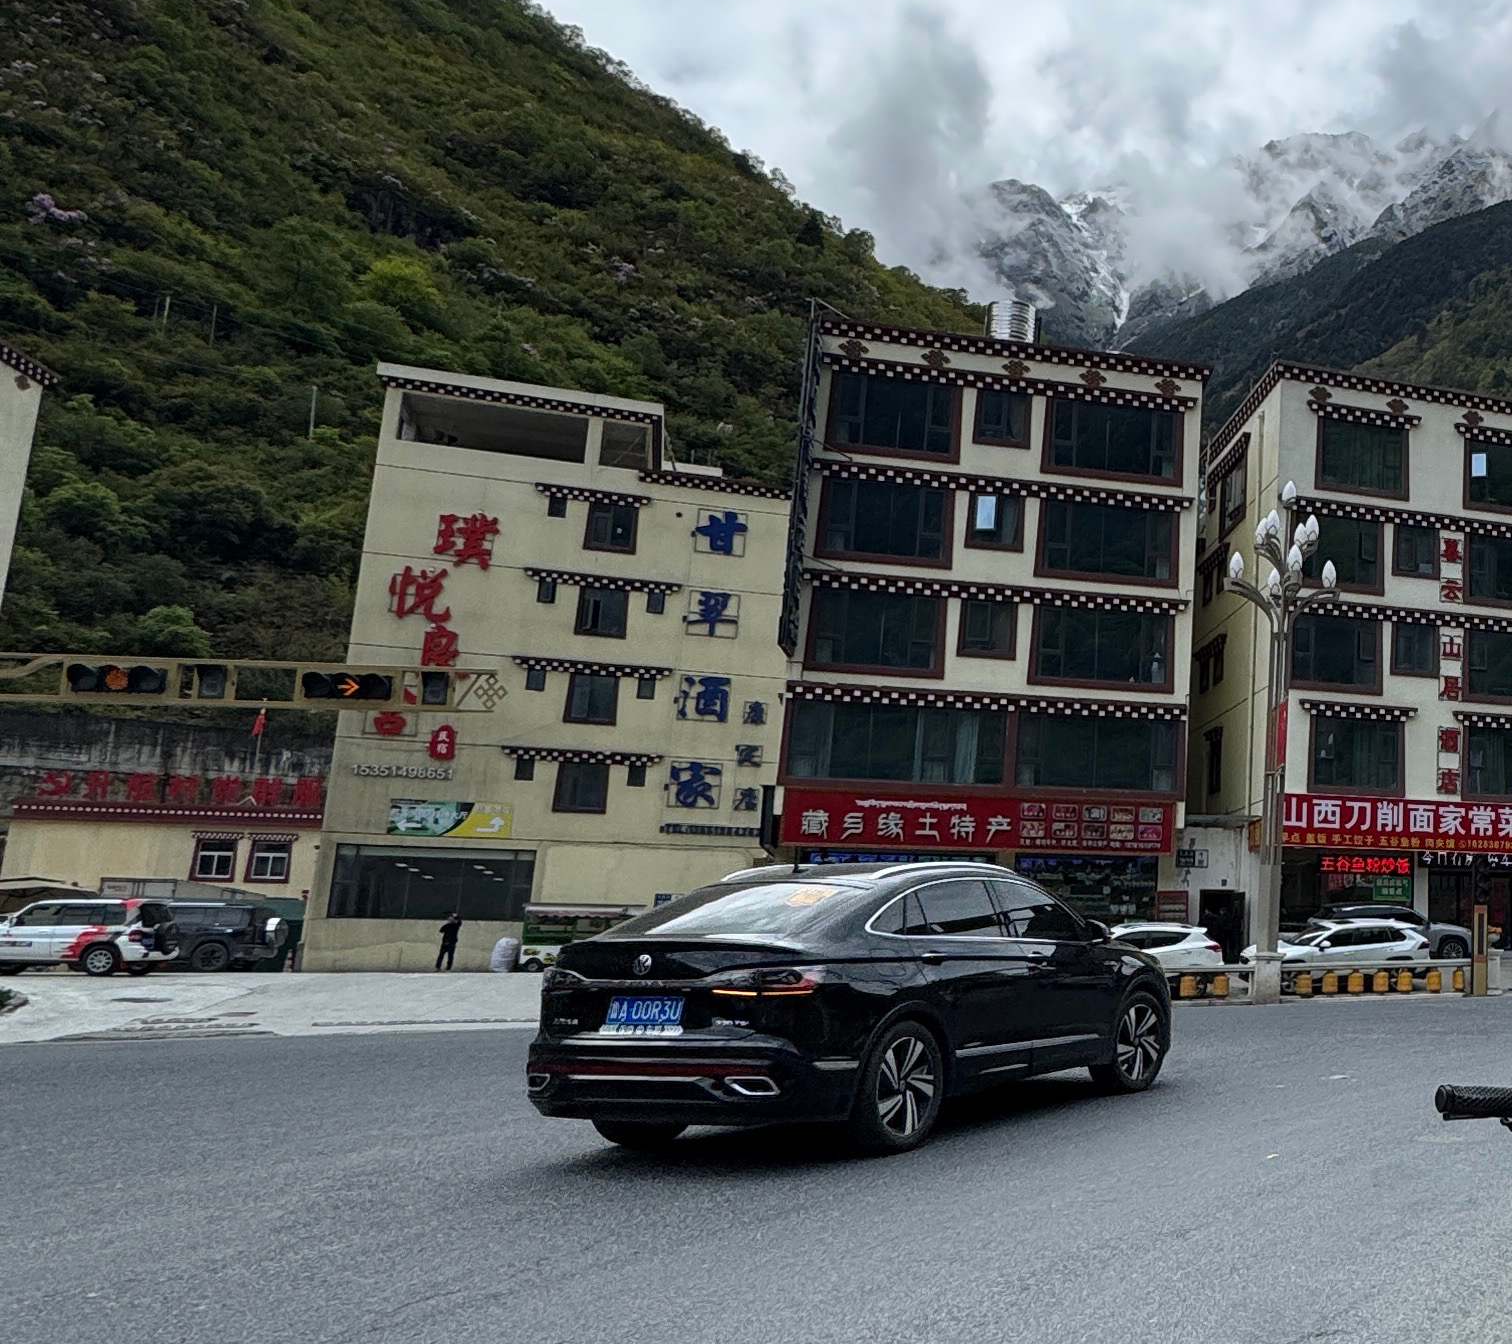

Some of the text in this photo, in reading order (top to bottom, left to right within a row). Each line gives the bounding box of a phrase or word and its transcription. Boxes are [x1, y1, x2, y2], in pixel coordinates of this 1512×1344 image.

[801, 809, 1012, 844] 藏乡缘土特产
